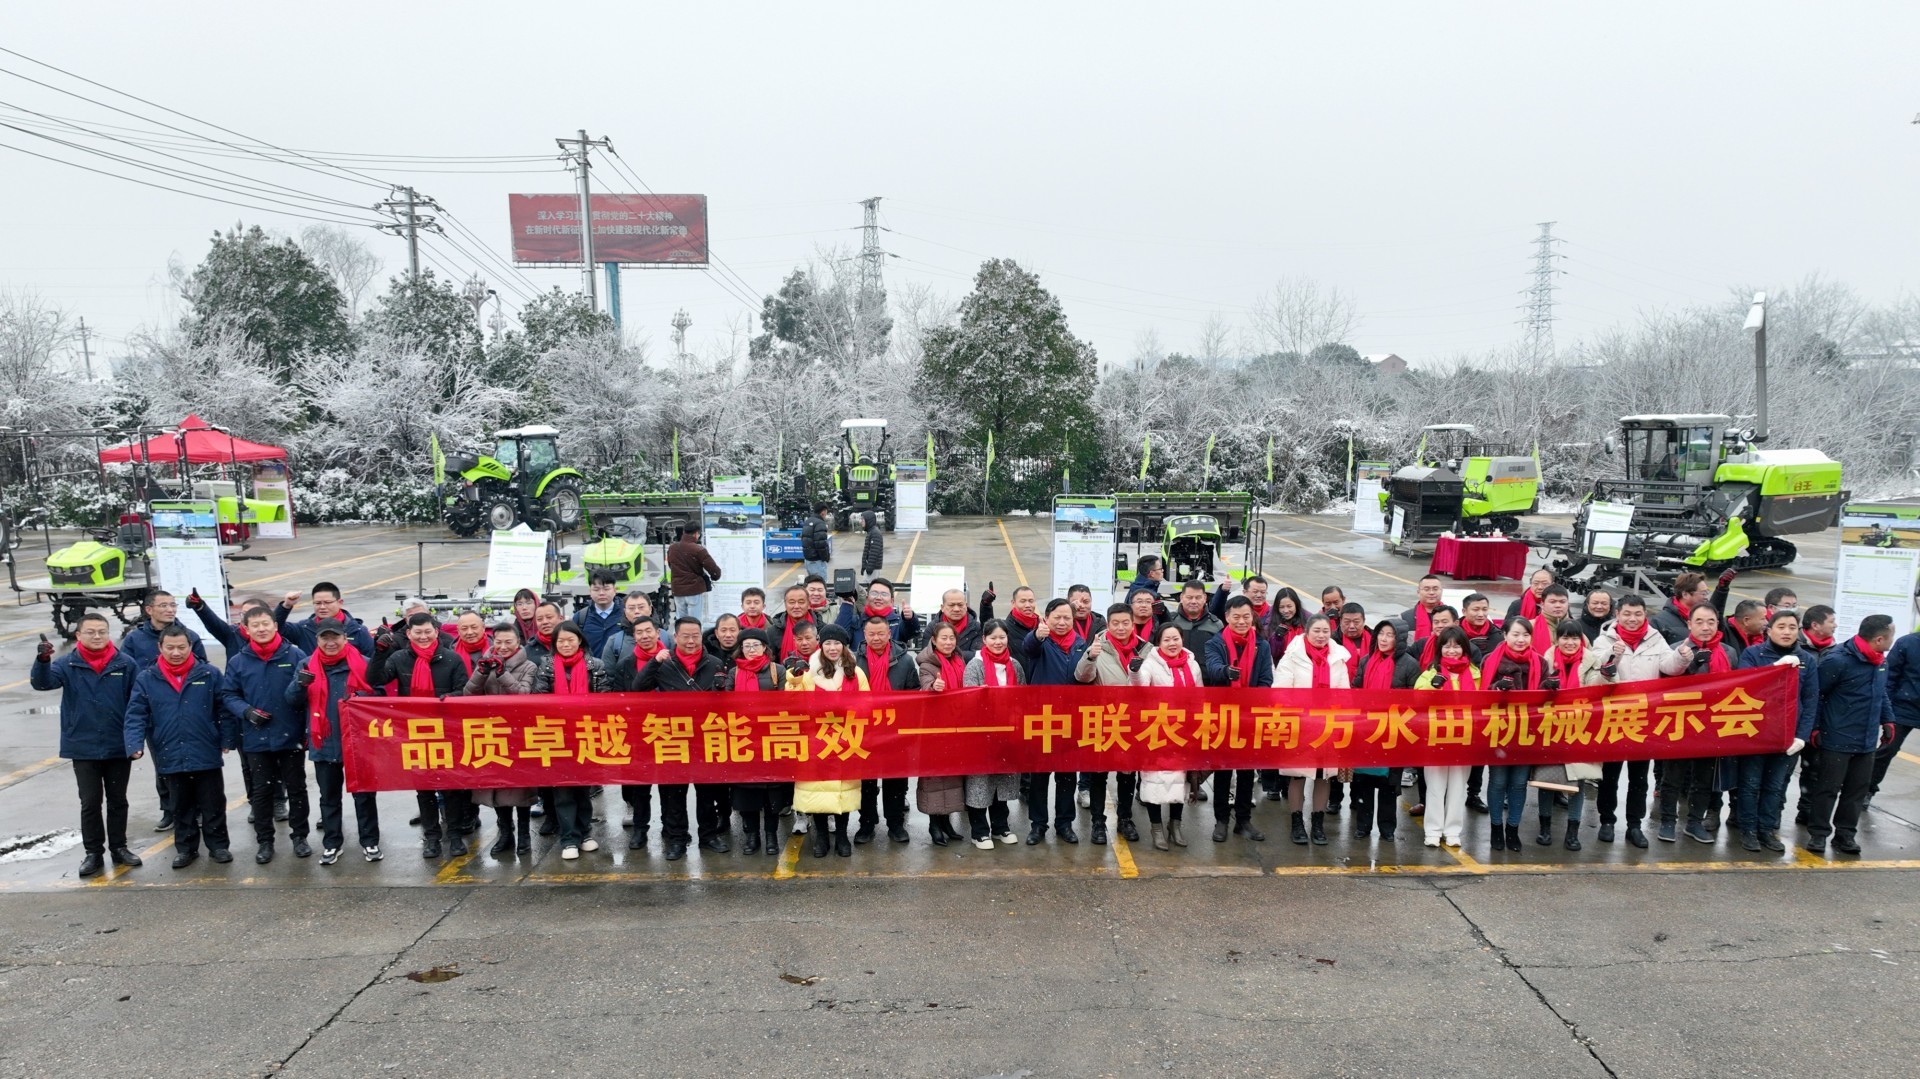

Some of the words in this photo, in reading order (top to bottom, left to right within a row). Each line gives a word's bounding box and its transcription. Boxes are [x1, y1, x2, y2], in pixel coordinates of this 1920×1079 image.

[537, 210, 674, 221] 深入学习宣贯彻党的二十大精神
